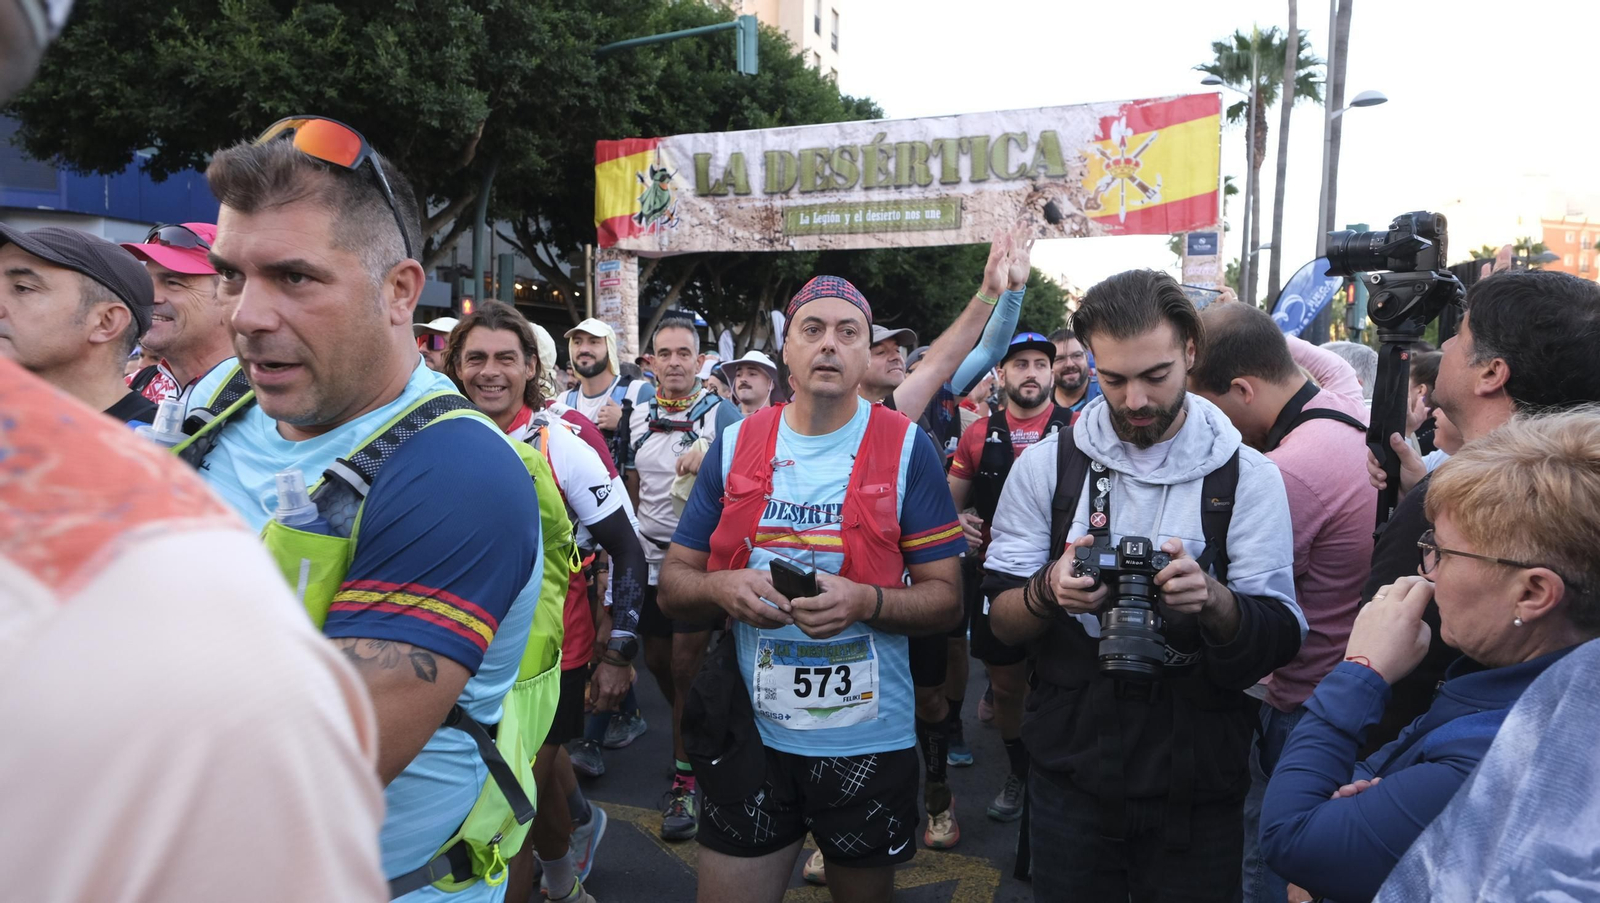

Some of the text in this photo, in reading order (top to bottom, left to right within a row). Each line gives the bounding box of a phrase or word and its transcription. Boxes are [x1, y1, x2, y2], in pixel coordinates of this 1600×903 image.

[693, 129, 1067, 196] LA DESÉRTICA
[800, 208, 942, 226] La Legión y el desierto nos une
[774, 642, 790, 657] LA
[793, 665, 852, 698] 573
